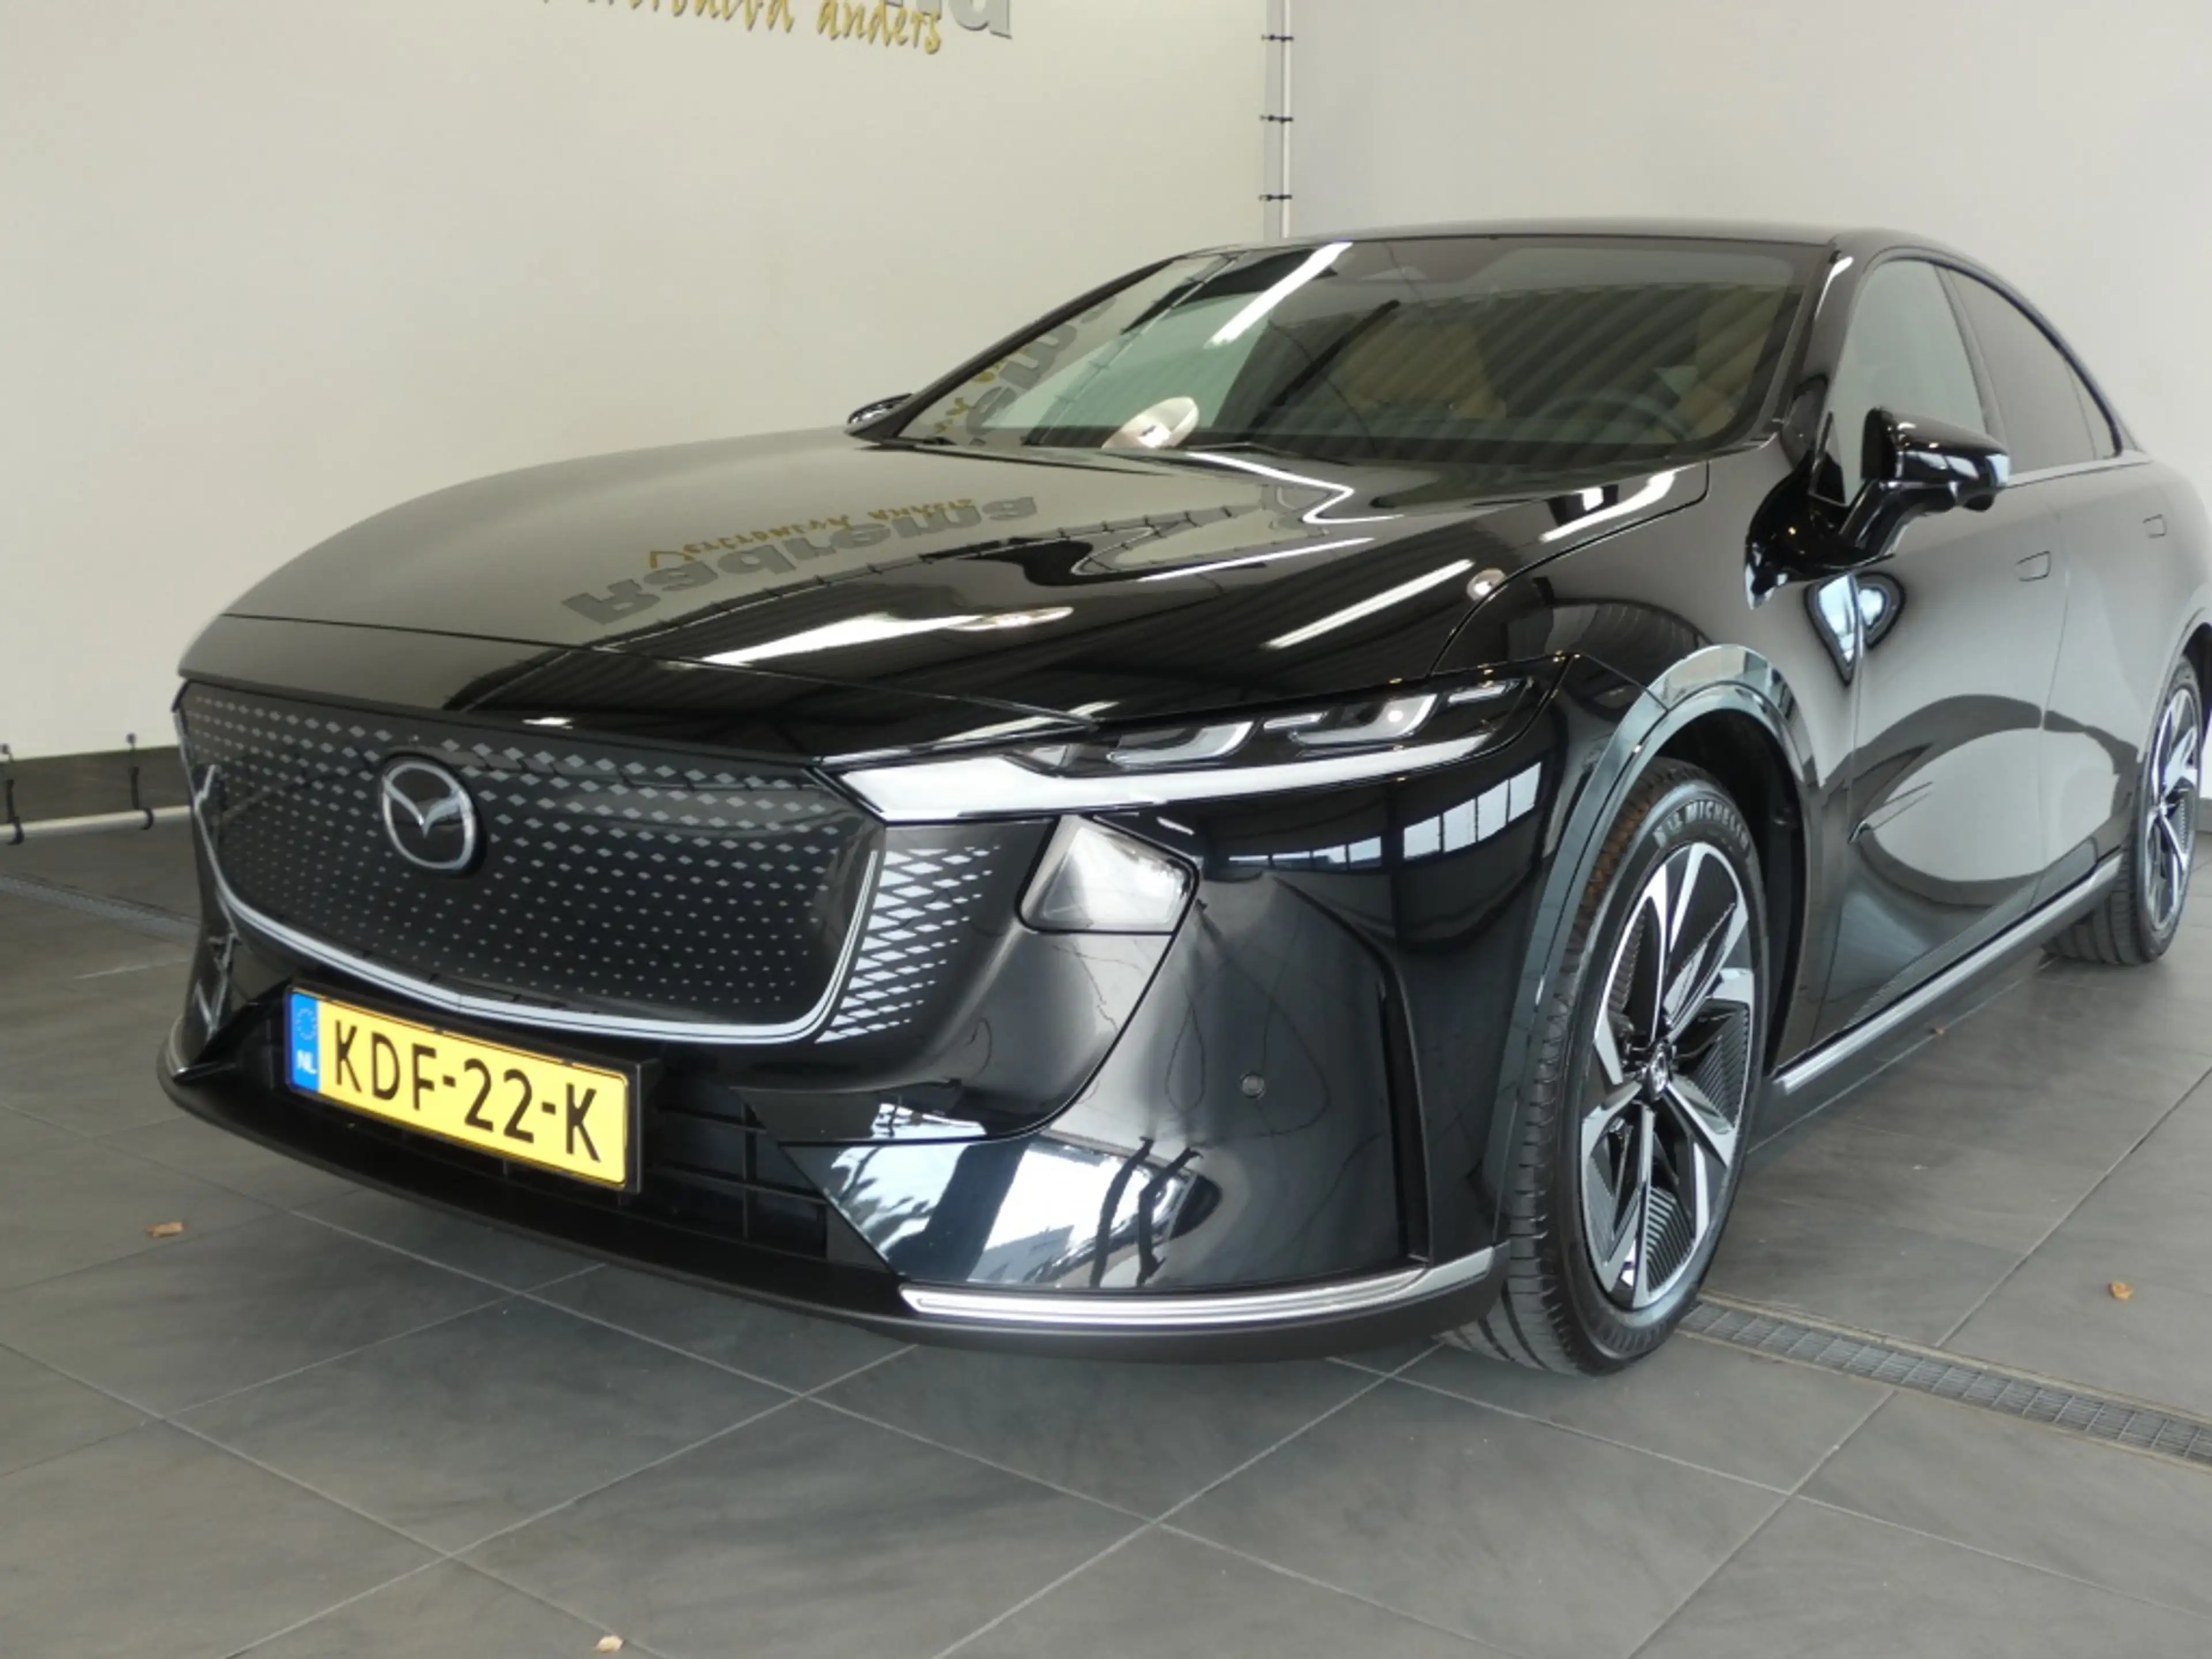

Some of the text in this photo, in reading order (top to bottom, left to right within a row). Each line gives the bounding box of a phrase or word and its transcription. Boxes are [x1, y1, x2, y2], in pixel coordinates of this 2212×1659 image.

[1685, 800, 1749, 851] MICHELIN
[297, 1049, 317, 1074] NL
[335, 1020, 601, 1163] KDF-22-K
